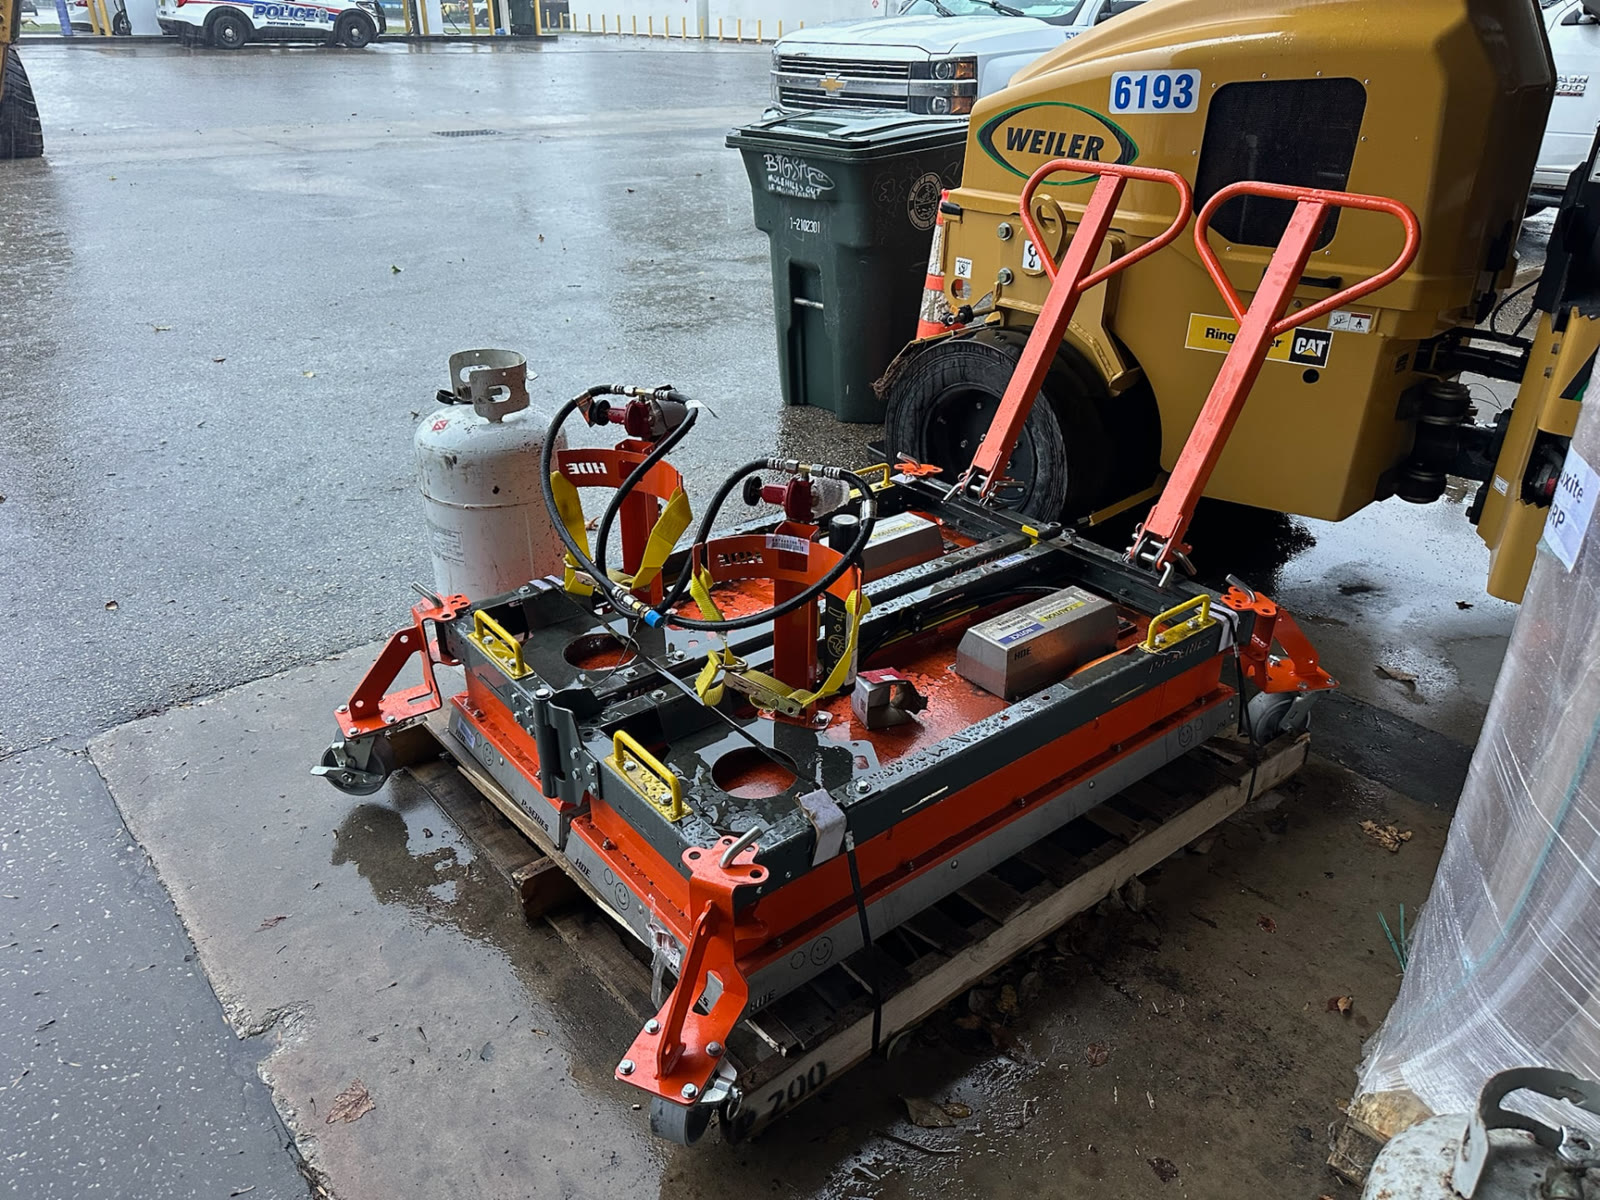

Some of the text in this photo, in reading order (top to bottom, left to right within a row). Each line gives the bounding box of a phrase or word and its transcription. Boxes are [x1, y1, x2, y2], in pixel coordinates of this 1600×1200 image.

[253, 4, 317, 21] POLICE
[1555, 75, 1589, 83] AM
[1114, 74, 1194, 110] 6193
[1006, 127, 1105, 161] WEILER
[1205, 327, 1236, 343] Ring
[1295, 337, 1326, 357] CAT
[1560, 471, 1583, 503] uxite
[1009, 627, 1034, 641] NOTICE
[1014, 646, 1032, 660] HDE
[520, 799, 549, 832] P-SERIES
[575, 858, 592, 879] HDE
